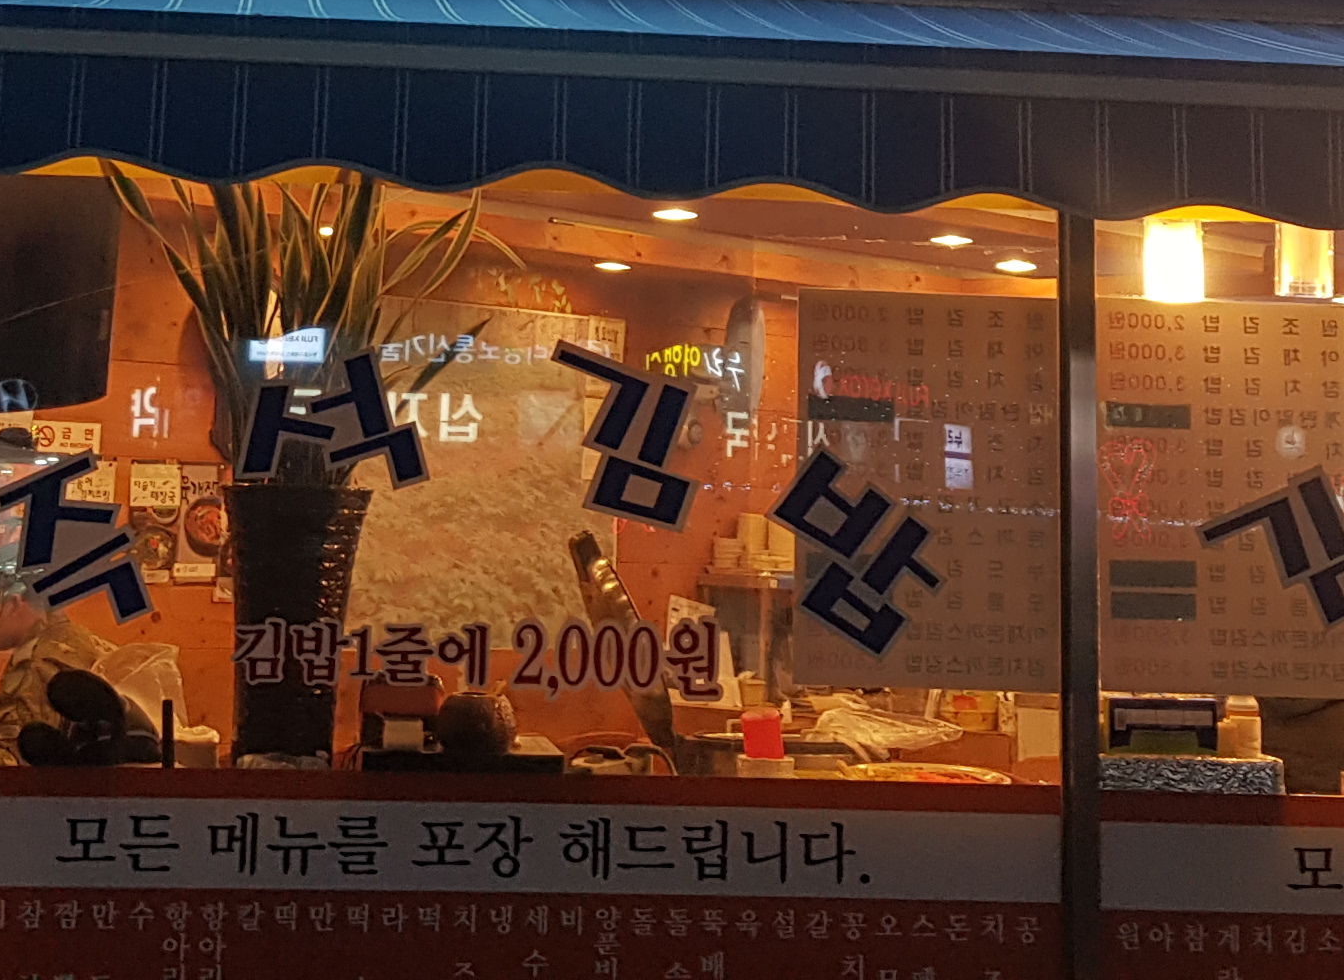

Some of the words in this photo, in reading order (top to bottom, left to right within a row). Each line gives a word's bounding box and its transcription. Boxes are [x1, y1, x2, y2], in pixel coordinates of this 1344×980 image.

[233, 617, 492, 688] 김밥1줄에
[512, 617, 725, 702] 2,000원
[55, 811, 180, 874] 모든
[207, 811, 389, 877] 메뉴를
[410, 815, 534, 880] 포장
[558, 816, 872, 885] 해드립니다.
